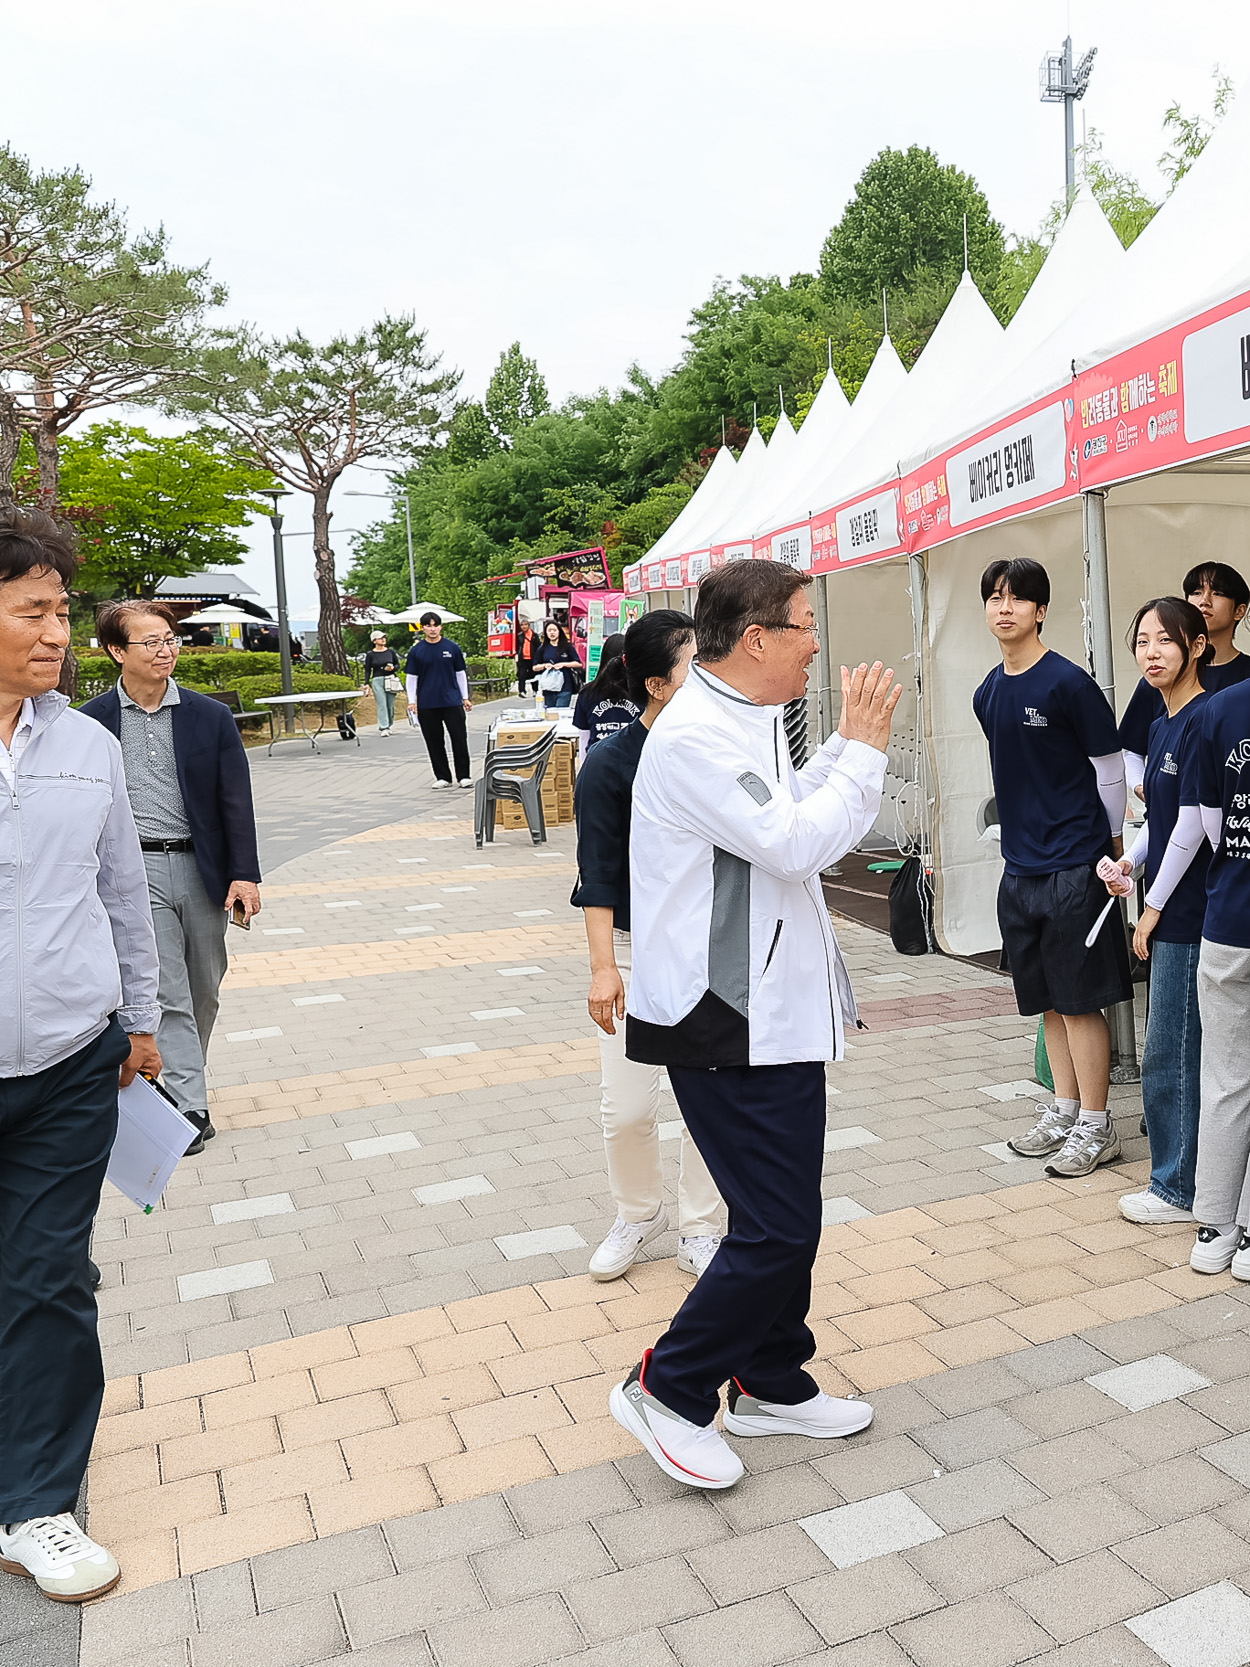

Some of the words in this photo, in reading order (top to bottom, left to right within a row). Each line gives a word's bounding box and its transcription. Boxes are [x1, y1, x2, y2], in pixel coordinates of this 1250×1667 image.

[1081, 386, 1119, 429] 반려동물과
[1121, 372, 1156, 414] 함께하는
[1158, 360, 1178, 398] 축제
[968, 449, 1003, 503] 베이커리
[1003, 434, 1036, 489] 멍카페
